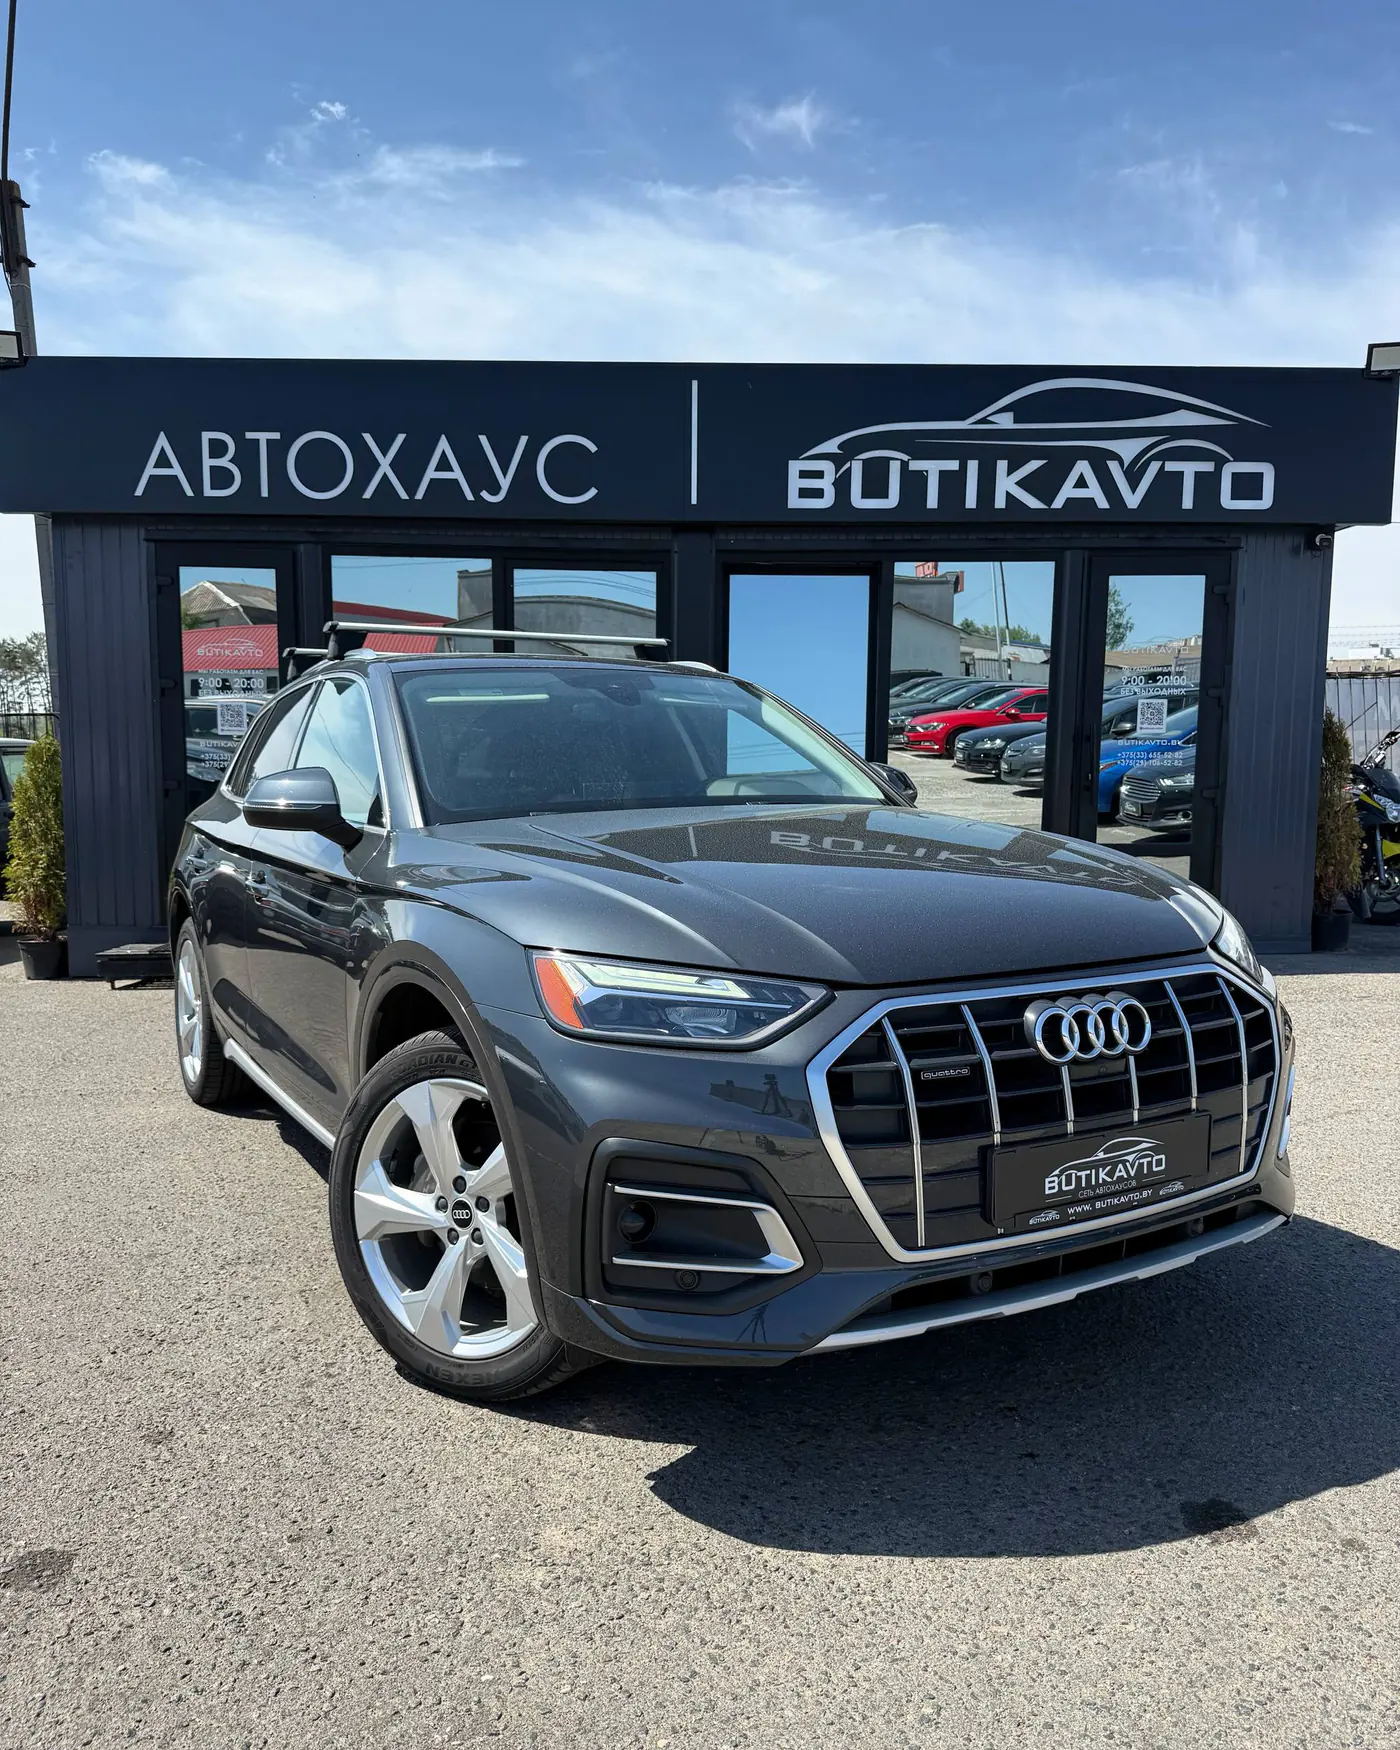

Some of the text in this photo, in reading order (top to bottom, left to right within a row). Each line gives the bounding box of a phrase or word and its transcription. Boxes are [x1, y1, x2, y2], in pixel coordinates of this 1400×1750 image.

[134, 430, 598, 504] АВТОХАУС
[787, 459, 1276, 510] BUTIKAVTO
[197, 648, 264, 657] BUTIKAVTO
[198, 677, 222, 688] 9:00
[233, 678, 264, 689] 20:00
[1121, 675, 1145, 686] 9:00
[1156, 675, 1187, 686] 20:00
[1121, 687, 1186, 696] БЕЗ ВЫХОДНЫХ
[1117, 751, 1147, 760] +375(33)
[923, 1068, 969, 1079] quattro
[1044, 1154, 1166, 1195] BUTIKAVTO
[1078, 1179, 1137, 1199] СЕТЬ АВТОХАУСОВ
[1067, 1188, 1153, 1215] WWW. BUTIKAVTO.BY
